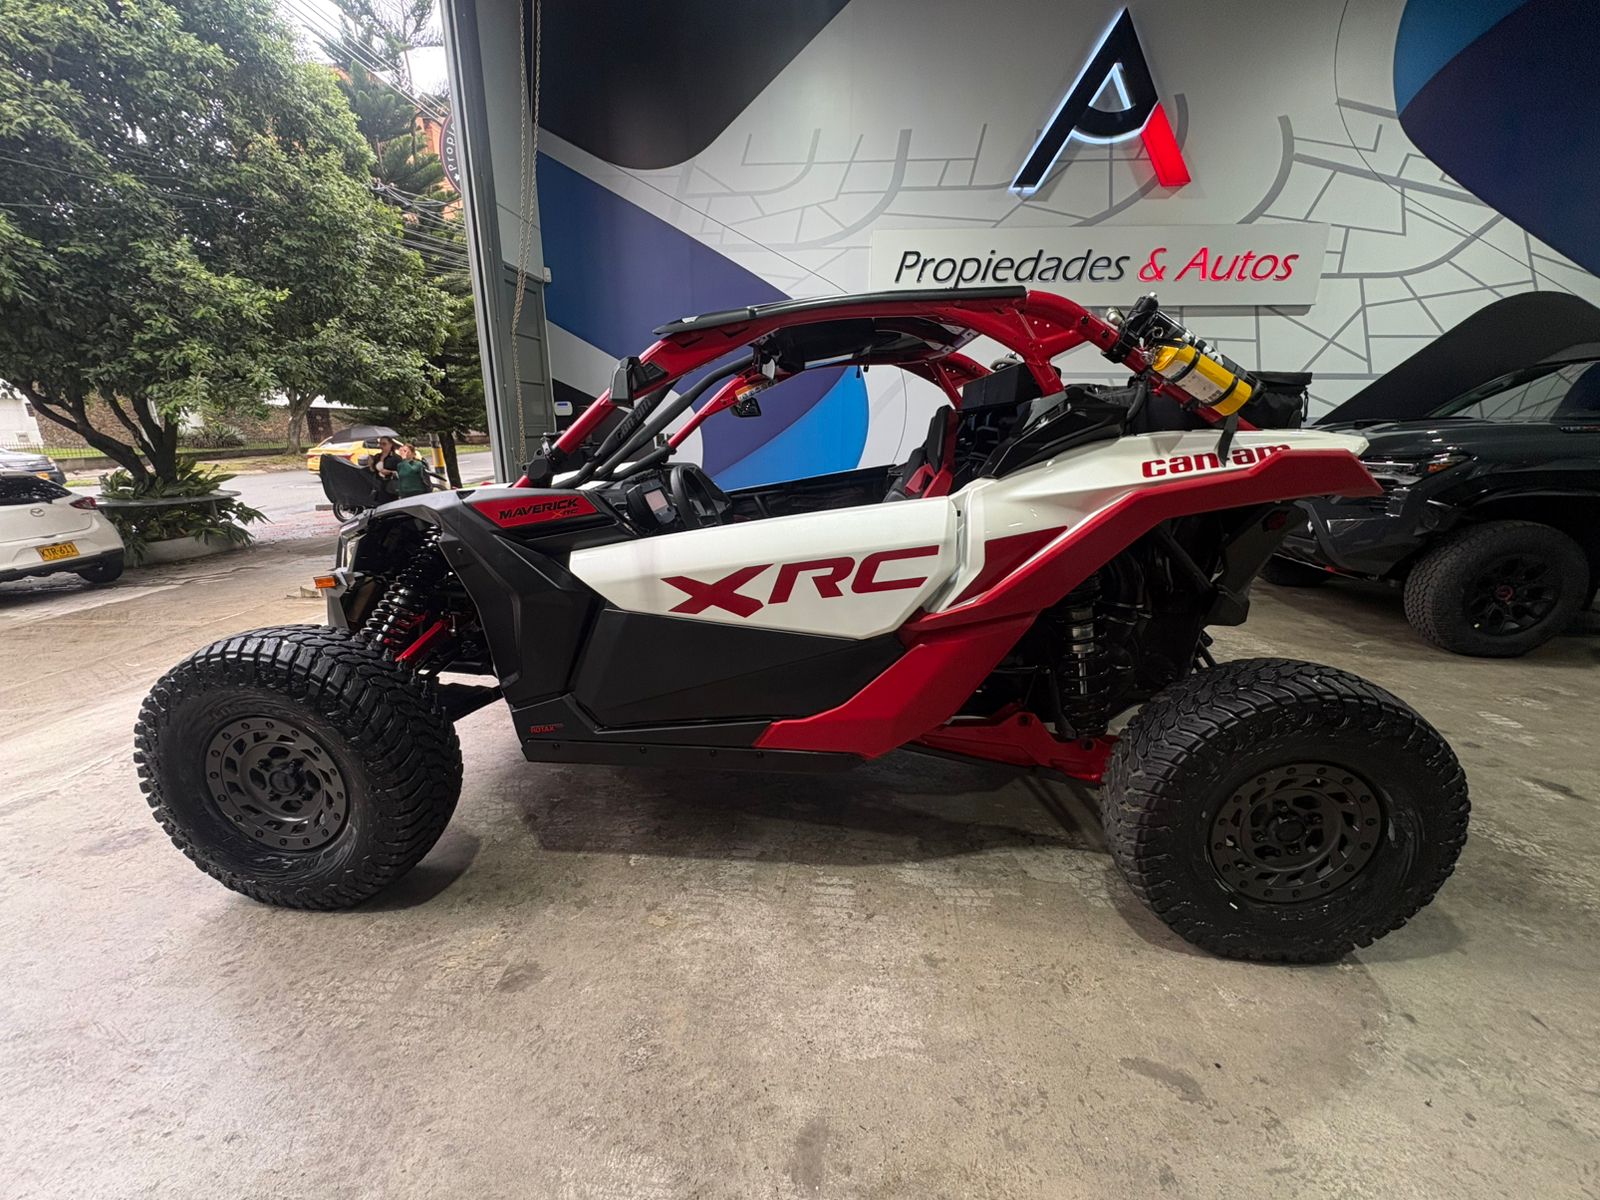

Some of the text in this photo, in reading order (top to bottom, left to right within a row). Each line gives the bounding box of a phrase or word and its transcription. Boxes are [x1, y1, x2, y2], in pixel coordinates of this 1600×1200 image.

[895, 247, 1299, 288] Propiedades & Autos
[1142, 444, 1291, 478] canam
[498, 498, 579, 520] MAVERICK
[660, 545, 940, 618] XRC
